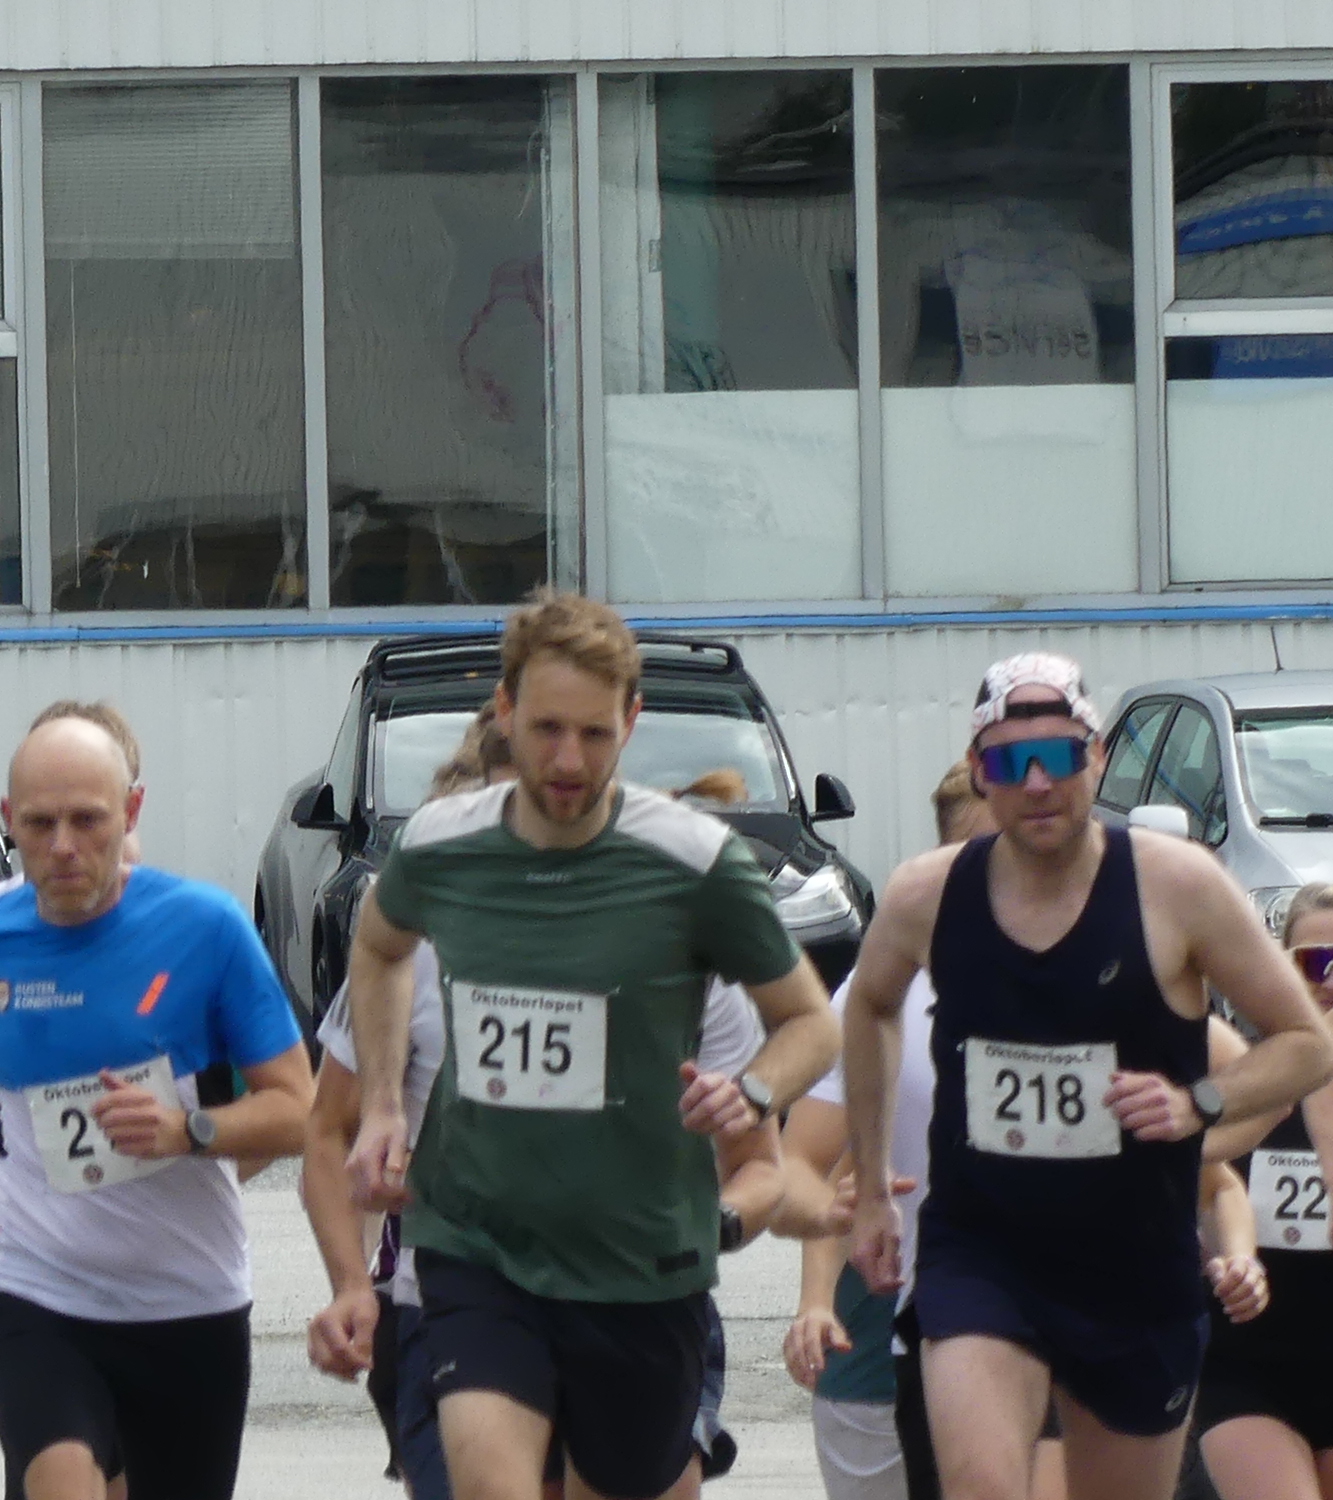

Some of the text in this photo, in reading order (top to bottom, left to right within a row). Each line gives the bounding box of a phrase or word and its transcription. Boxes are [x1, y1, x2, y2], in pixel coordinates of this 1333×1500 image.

[478, 1014, 572, 1075] 215
[995, 1068, 1086, 1126] 218
[1274, 1175, 1327, 1221] 22
